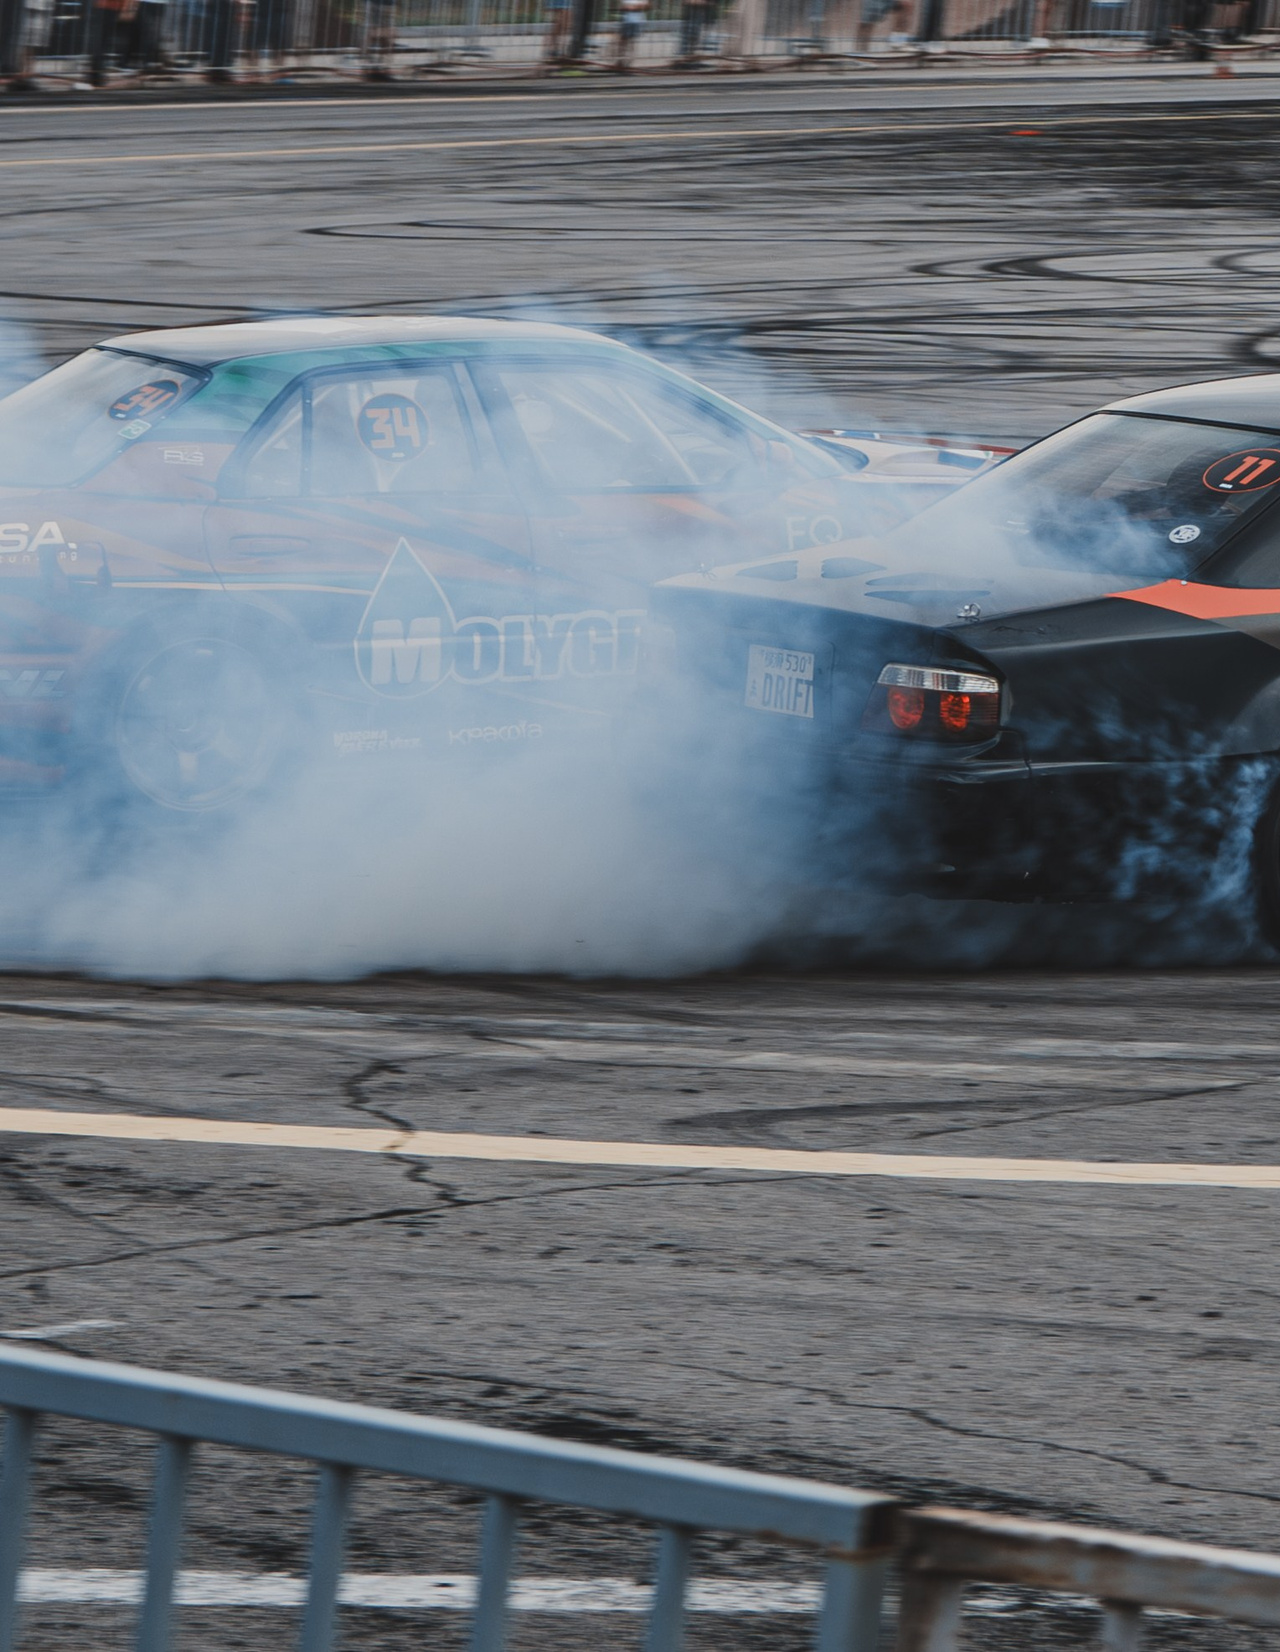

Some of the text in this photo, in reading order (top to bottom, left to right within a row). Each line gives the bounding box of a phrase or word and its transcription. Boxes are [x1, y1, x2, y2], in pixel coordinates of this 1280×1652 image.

[112, 385, 176, 417] 34
[365, 406, 422, 449] 34
[1222, 454, 1277, 486] 11
[784, 514, 843, 551] FQ
[0, 551, 77, 564] unng
[785, 653, 807, 674] 530
[761, 671, 815, 715] DRIFT
